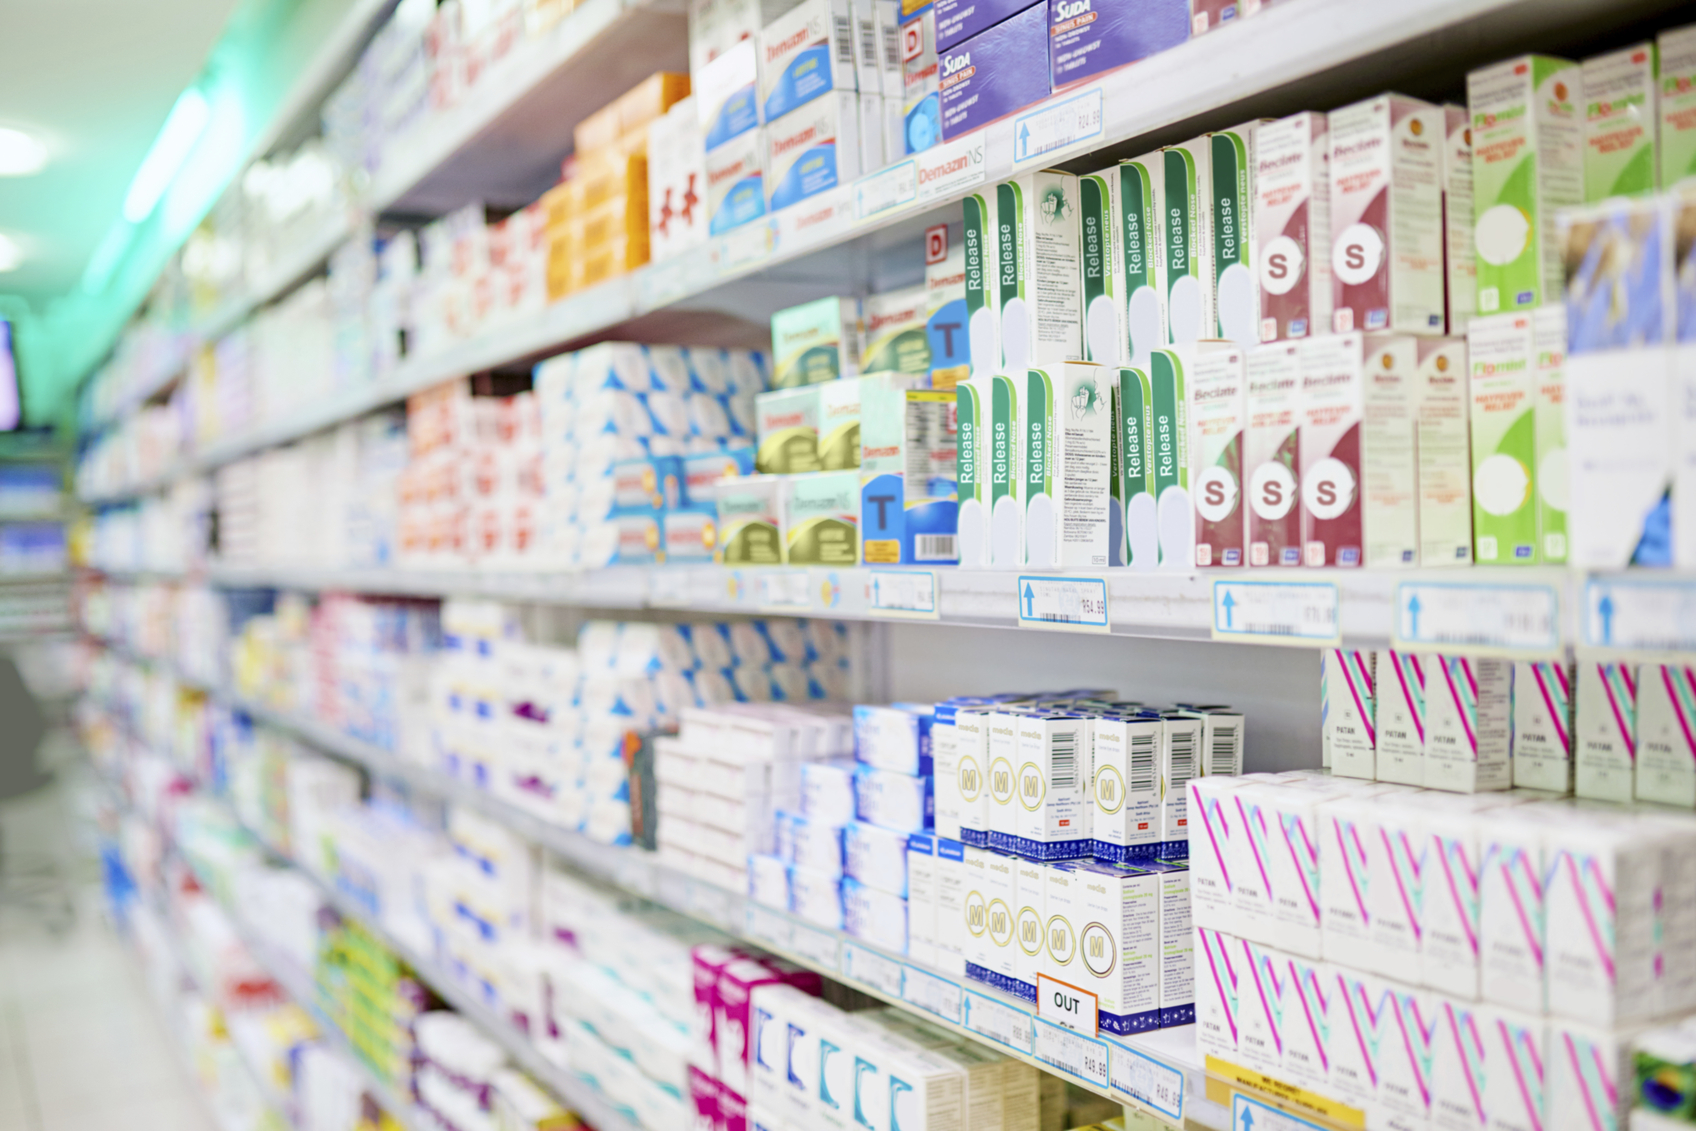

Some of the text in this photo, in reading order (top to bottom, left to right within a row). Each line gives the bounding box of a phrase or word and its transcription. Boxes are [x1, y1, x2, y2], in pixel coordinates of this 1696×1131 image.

[1054, 0, 1090, 22] SUDA
[908, 30, 917, 53] D
[943, 52, 971, 77] SUDA
[1078, 110, 1100, 130] R24.99
[918, 156, 968, 185] Demazin
[1171, 208, 1185, 270] Release
[1220, 197, 1236, 260] Release
[932, 234, 941, 256] D
[1001, 224, 1015, 286] Release
[1086, 217, 1100, 278] Release
[1128, 213, 1142, 274] Release
[967, 229, 981, 290] Release
[1268, 254, 1288, 279] S
[1345, 244, 1365, 269] S
[932, 322, 962, 358] T
[1194, 387, 1237, 401] Beclate
[960, 422, 973, 484] Release
[994, 422, 1006, 484] Release
[1030, 422, 1042, 484] Release
[1127, 417, 1141, 478] Release
[1159, 415, 1173, 477] Release
[1204, 480, 1225, 506] S
[1262, 480, 1283, 506] S
[1316, 480, 1337, 506] S
[867, 495, 896, 531] T
[1082, 599, 1104, 615] R54.99
[1336, 726, 1356, 735] PATAN
[1385, 730, 1407, 739] PATAN
[962, 769, 976, 791] M
[994, 772, 1008, 793] M
[1024, 776, 1038, 798] M
[1100, 779, 1114, 801] M
[969, 905, 983, 927] M
[992, 912, 1006, 934] M
[1023, 921, 1036, 942] M
[1052, 929, 1066, 951] M
[1090, 936, 1104, 958] M
[1054, 992, 1080, 1015] OUT
[1203, 1021, 1221, 1032] PATAN
[1245, 1035, 1265, 1047] PATAN
[1085, 1056, 1106, 1078] R49.99
[1156, 1083, 1180, 1108] R49.99
